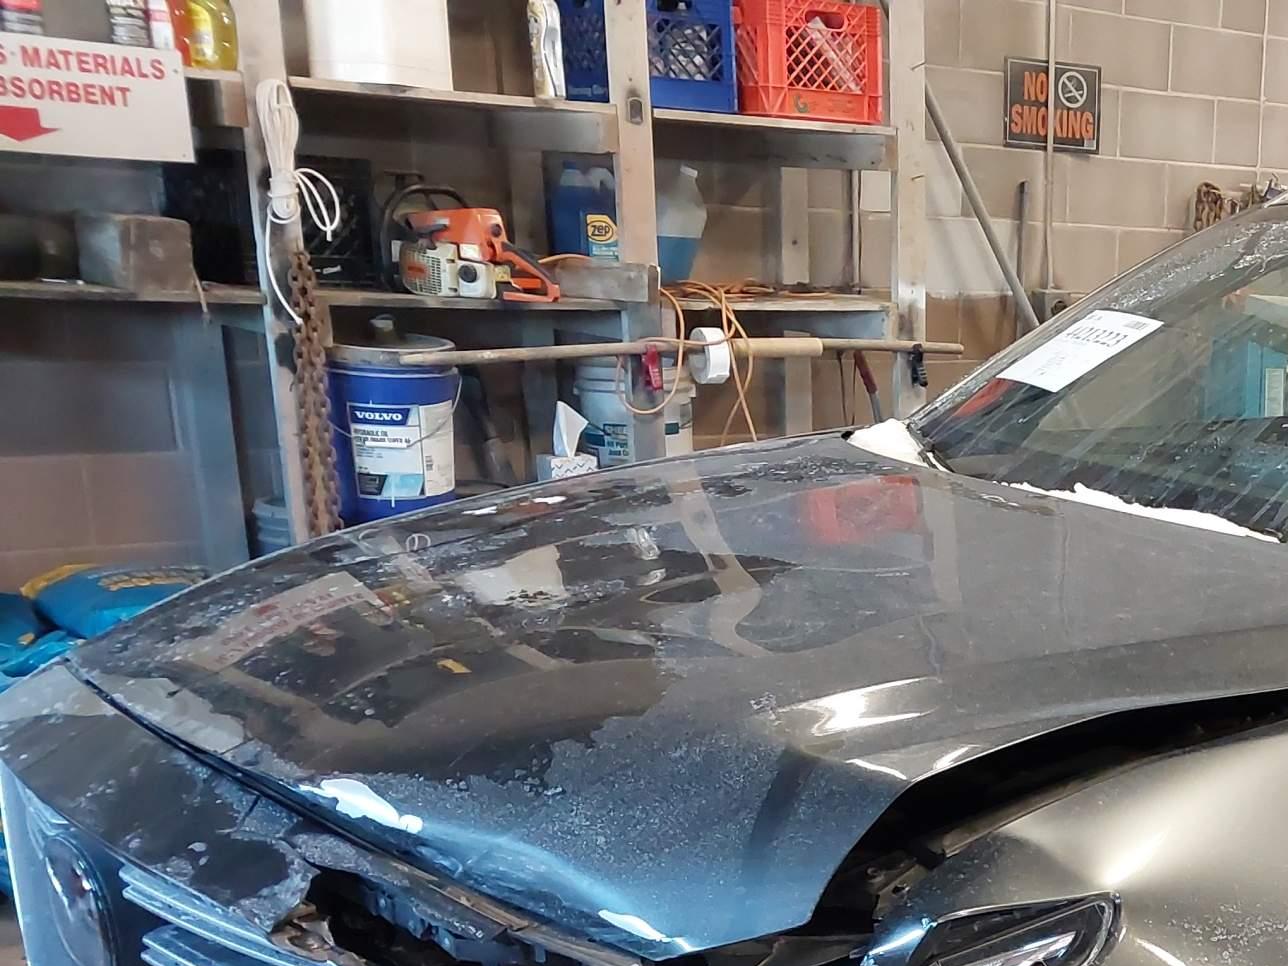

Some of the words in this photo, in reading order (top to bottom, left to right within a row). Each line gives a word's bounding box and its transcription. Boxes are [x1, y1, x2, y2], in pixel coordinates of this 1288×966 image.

[20, 45, 166, 80] MATERIALS
[1023, 71, 1048, 102] NO
[354, 410, 403, 421] VOLVO
